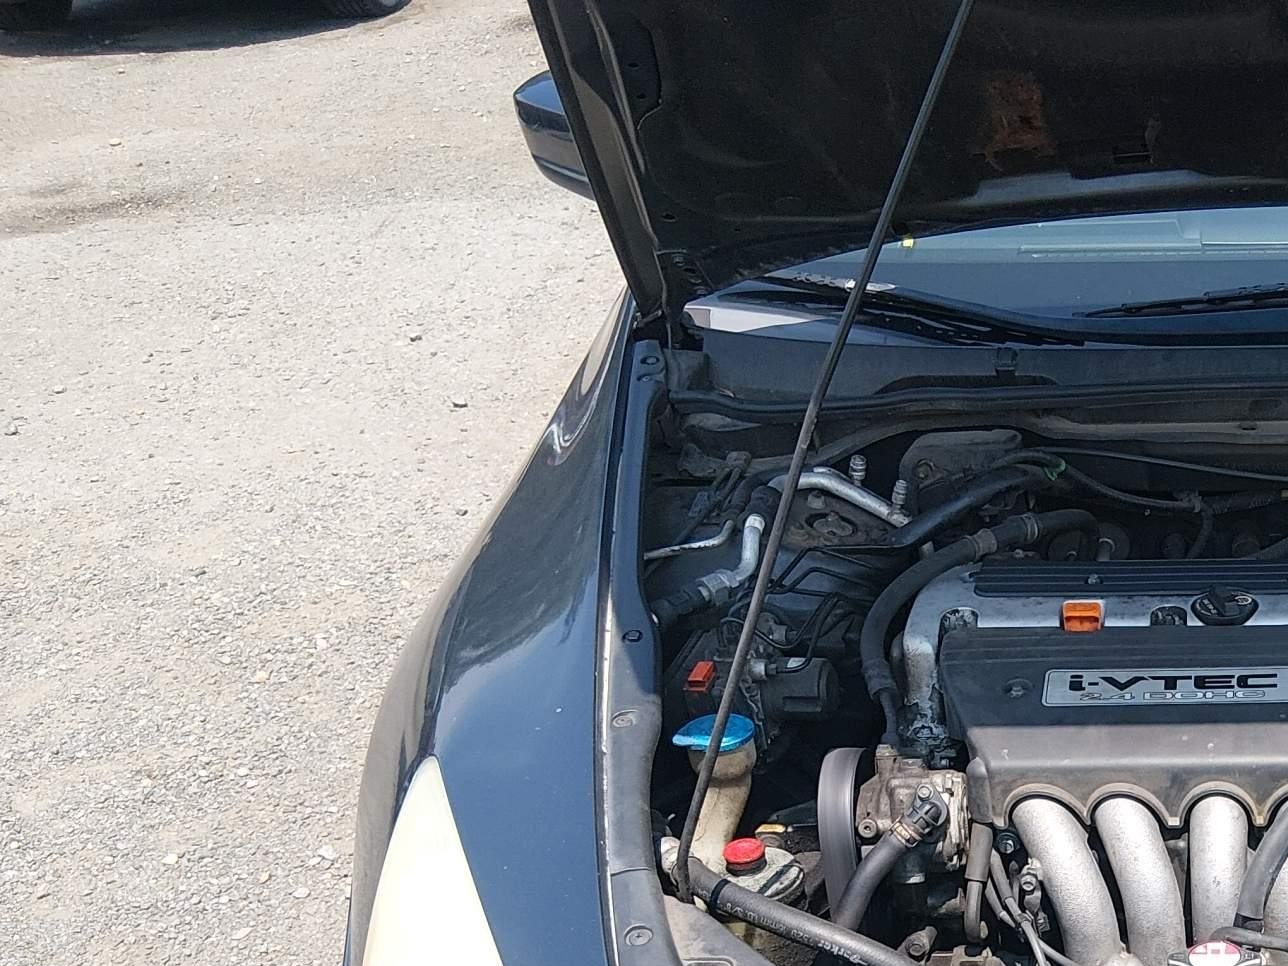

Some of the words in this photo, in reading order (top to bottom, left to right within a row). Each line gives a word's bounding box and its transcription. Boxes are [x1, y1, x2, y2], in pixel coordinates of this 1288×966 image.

[1068, 673, 1278, 691] i-VTEC
[1079, 690, 1135, 701] 2.4
[1142, 689, 1267, 701] DOHC
